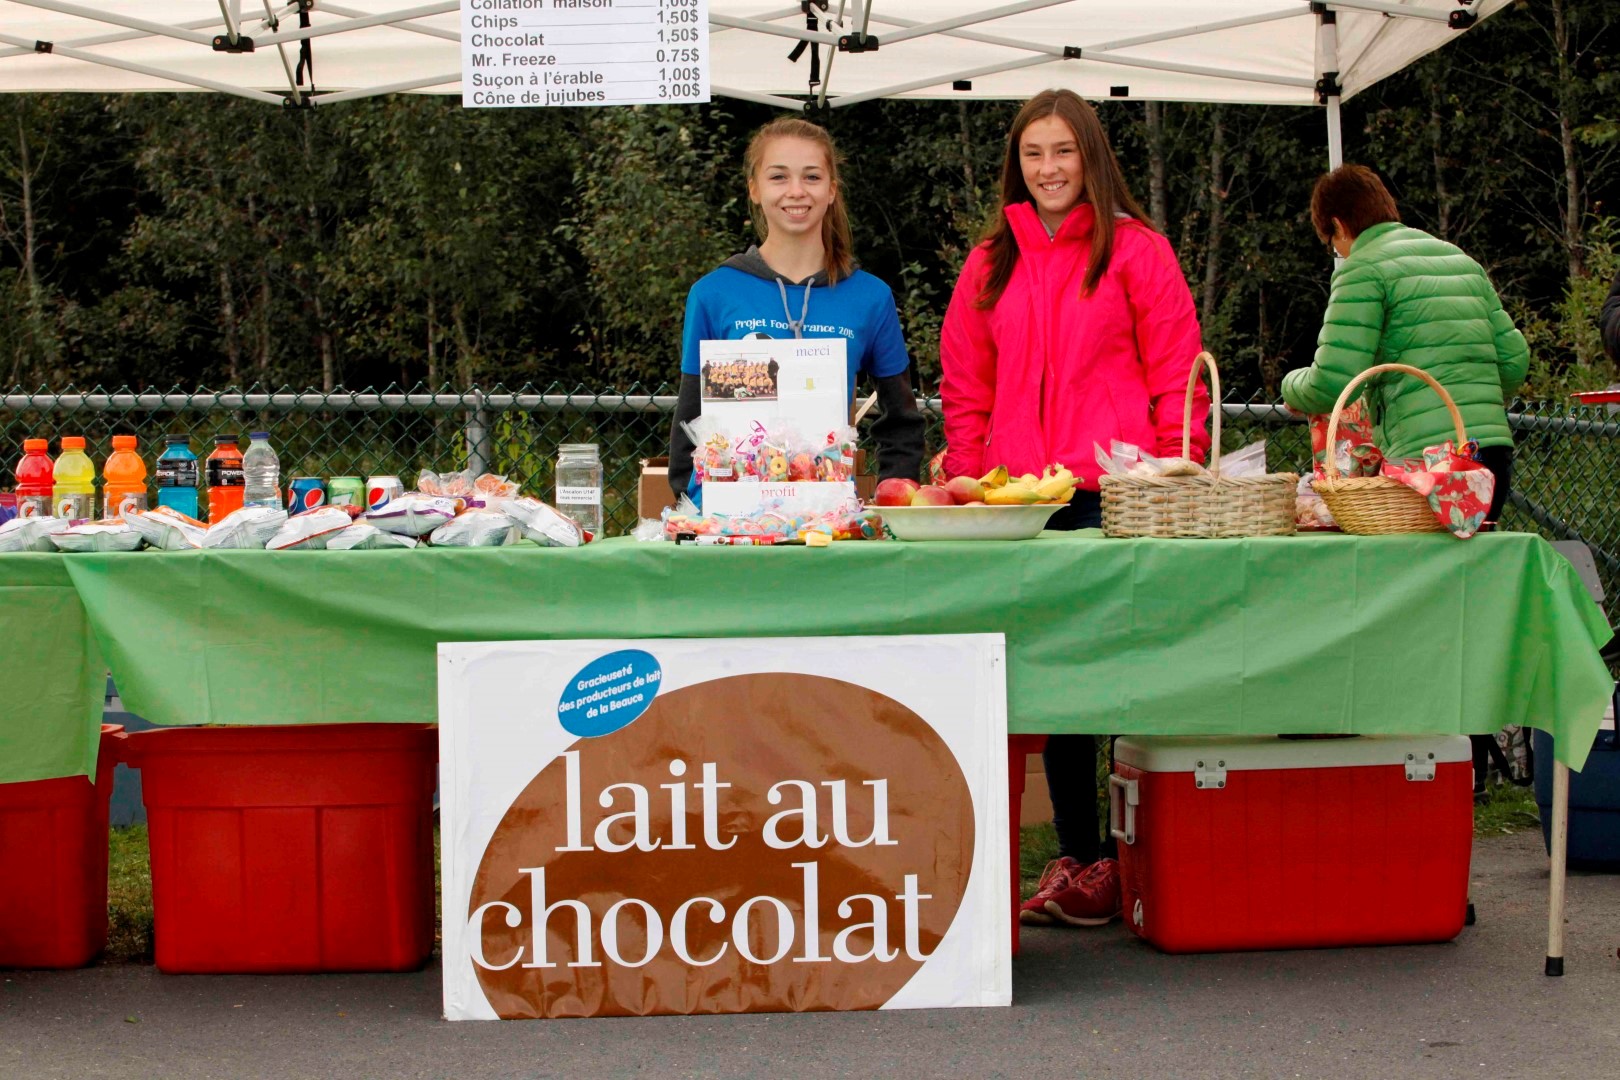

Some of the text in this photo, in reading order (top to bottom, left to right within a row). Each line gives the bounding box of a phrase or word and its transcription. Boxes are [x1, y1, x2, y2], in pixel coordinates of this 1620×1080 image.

[470, 0, 543, 10] Collation
[553, 0, 613, 9] maison
[471, 9, 699, 31] Chips 1,50$
[471, 28, 699, 47] Chocolat 1,50$
[472, 48, 700, 67] Mr. Freeze 0.75$
[472, 67, 700, 90] Suçon à l'érable 1,00$
[473, 83, 701, 106] Cône de jujubes 3,00$
[735, 318, 767, 331] Projet
[770, 319, 791, 330] Foo
[801, 323, 836, 333] rance
[796, 345, 830, 357] merci
[761, 486, 796, 501] profit
[577, 663, 633, 691] Gracieuseté
[558, 670, 661, 713] des producteurs de lait
[586, 693, 644, 719] de la Beauce
[554, 750, 899, 853] lait au
[467, 861, 935, 972] chocolat
